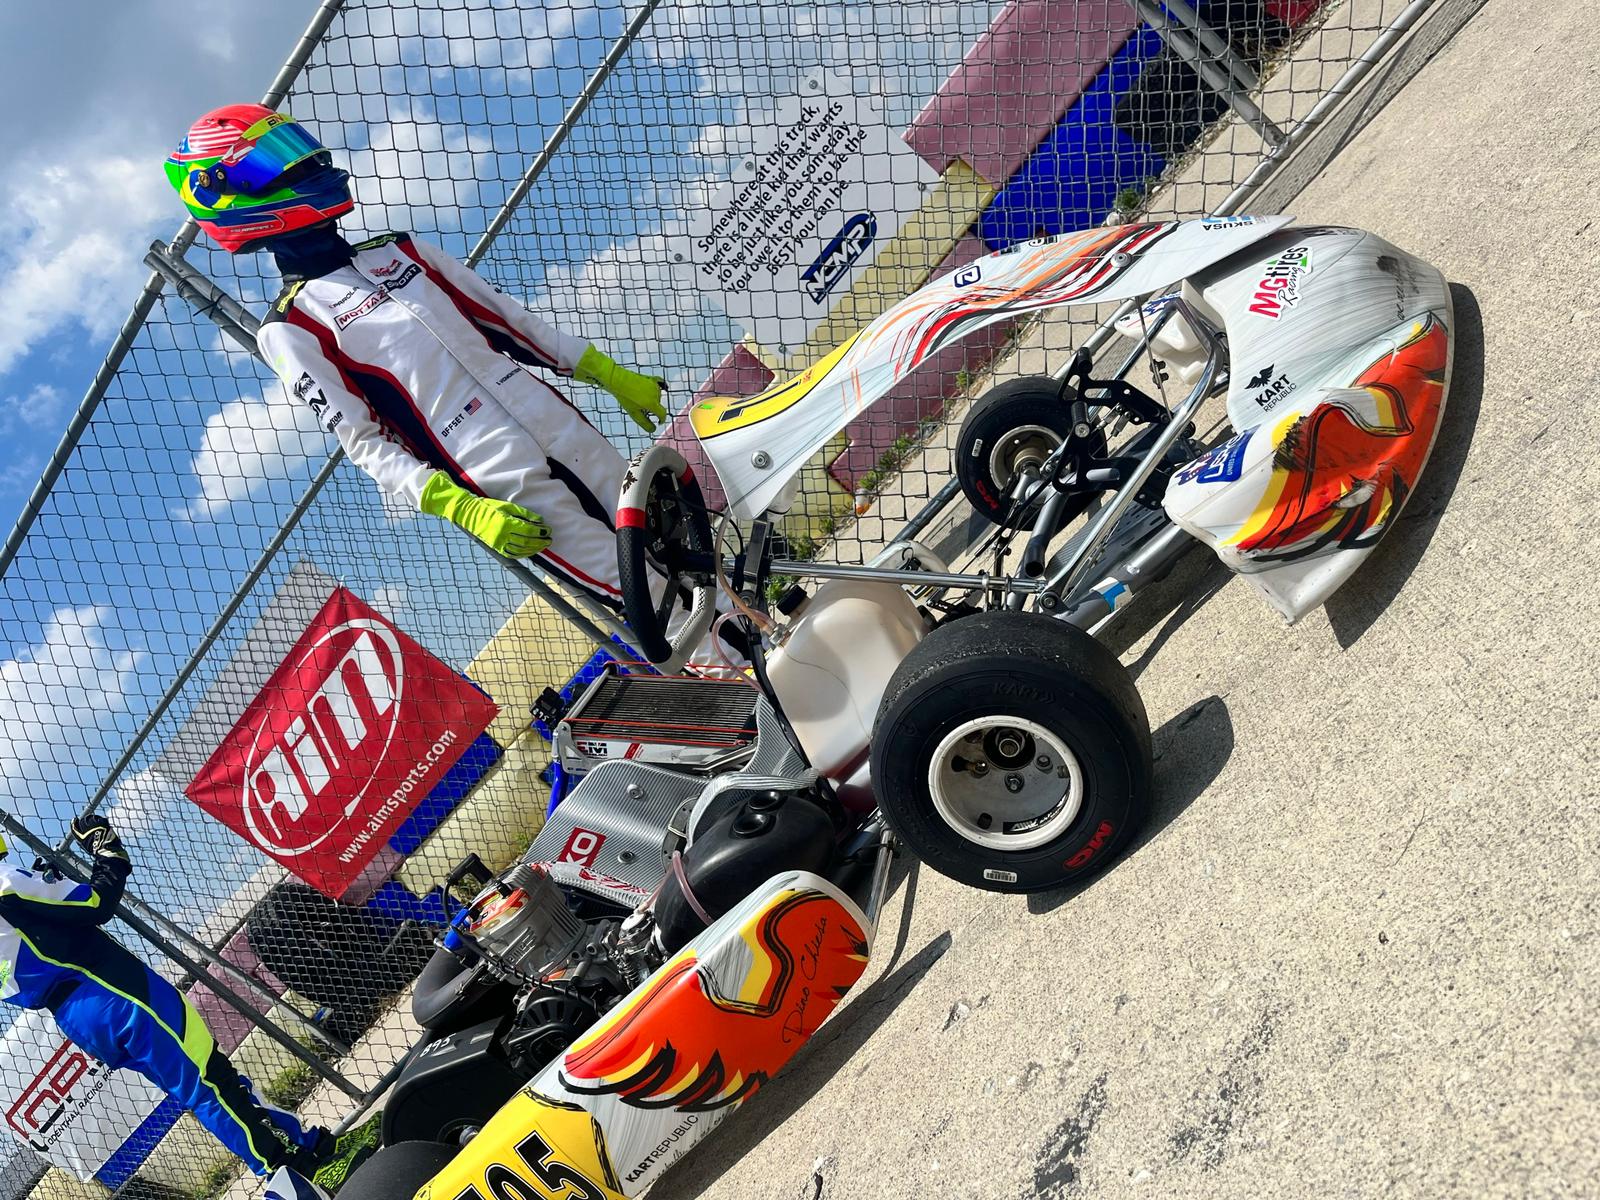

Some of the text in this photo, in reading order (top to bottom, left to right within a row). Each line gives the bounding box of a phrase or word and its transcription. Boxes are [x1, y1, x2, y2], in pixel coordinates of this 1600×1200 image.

[698, 106, 820, 253] Somewhere at this track,
[702, 102, 843, 275] there is a little kid that wants
[717, 268, 732, 283] to
[728, 252, 746, 269] be
[743, 226, 765, 256] just
[760, 205, 785, 229] like
[781, 181, 804, 208] you
[727, 130, 867, 294] You owe it to them to be the
[766, 241, 795, 276] BEST
[794, 221, 815, 248] you
[814, 198, 835, 221] can
[1202, 220, 1254, 231] SKUSA
[1278, 266, 1305, 306] Racing
[1255, 374, 1291, 407] KART
[1263, 382, 1297, 412] REPUBLIC
[441, 413, 465, 437] OFFSET
[338, 729, 458, 864] www.aimsports.com
[1063, 820, 1114, 869] MG
[79, 1081, 104, 1111] RACING
[625, 1114, 699, 1183] KARTREPUBLIC
